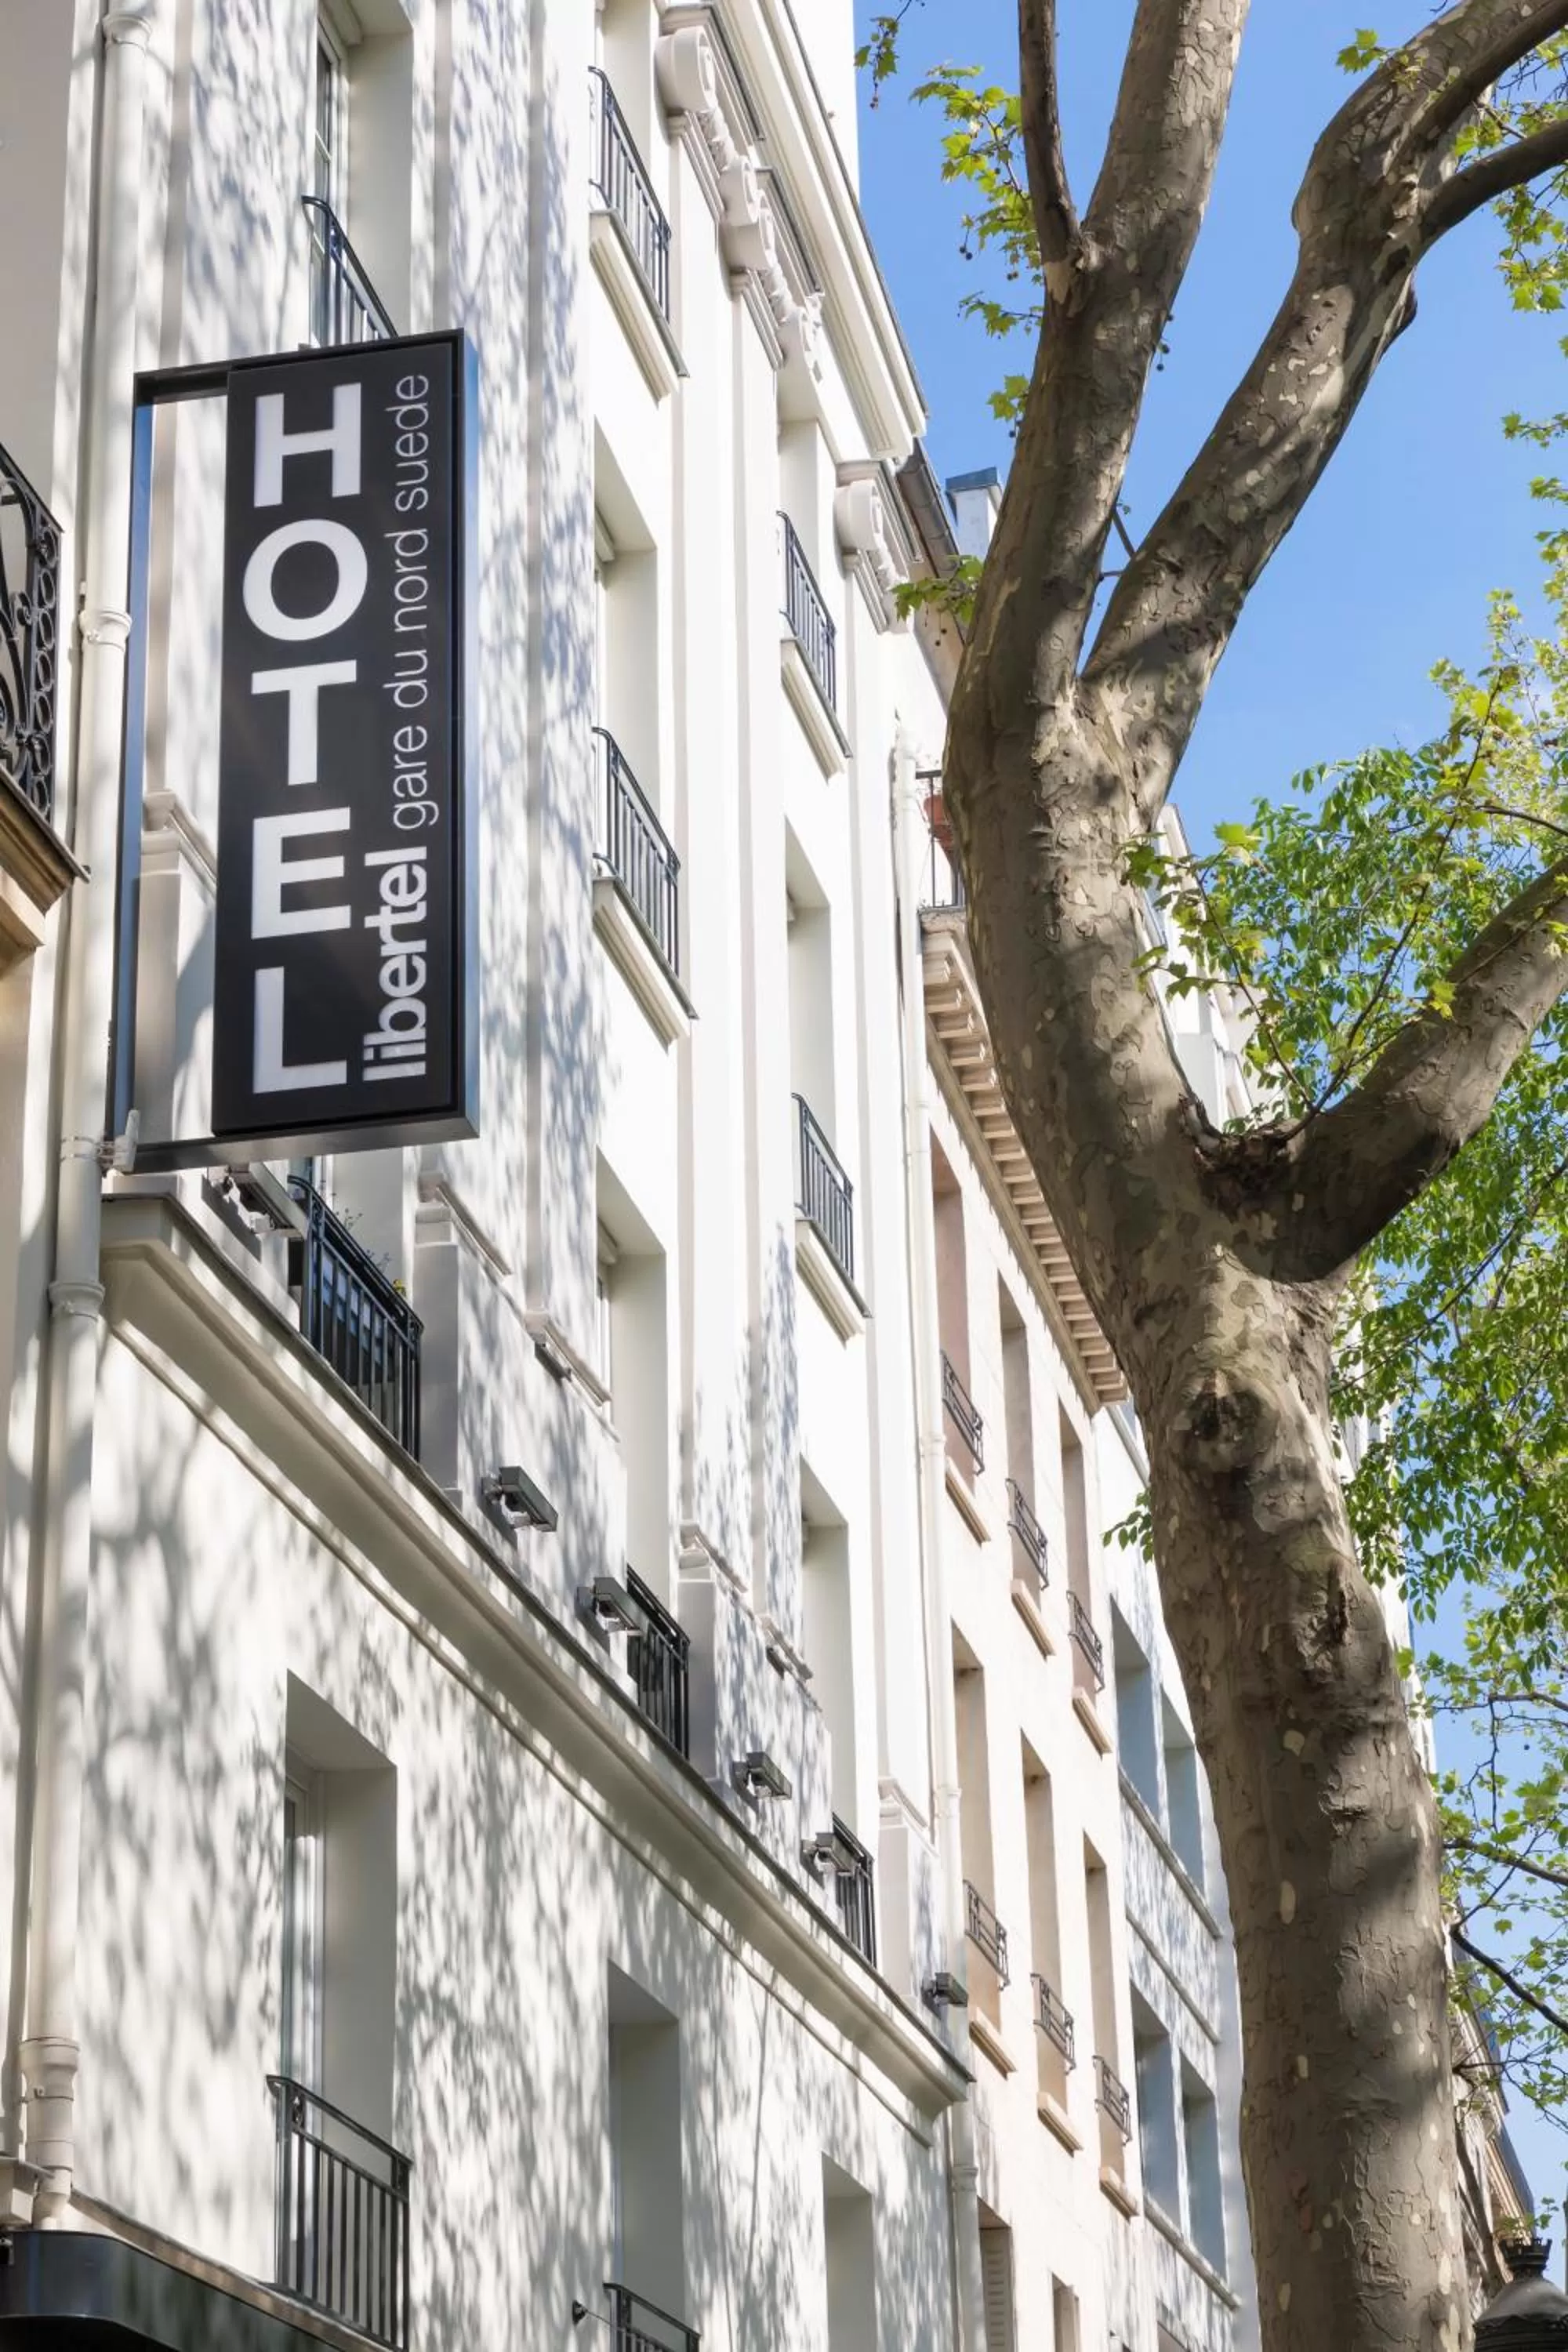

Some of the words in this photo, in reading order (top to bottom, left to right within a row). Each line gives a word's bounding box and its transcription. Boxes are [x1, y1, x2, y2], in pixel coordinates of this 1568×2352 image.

[385, 374, 429, 512] suede
[384, 528, 428, 633] nord
[242, 382, 368, 1094] HOTEL
[383, 649, 428, 708] du
[393, 724, 439, 831] gare
[363, 846, 427, 1081] libertel
